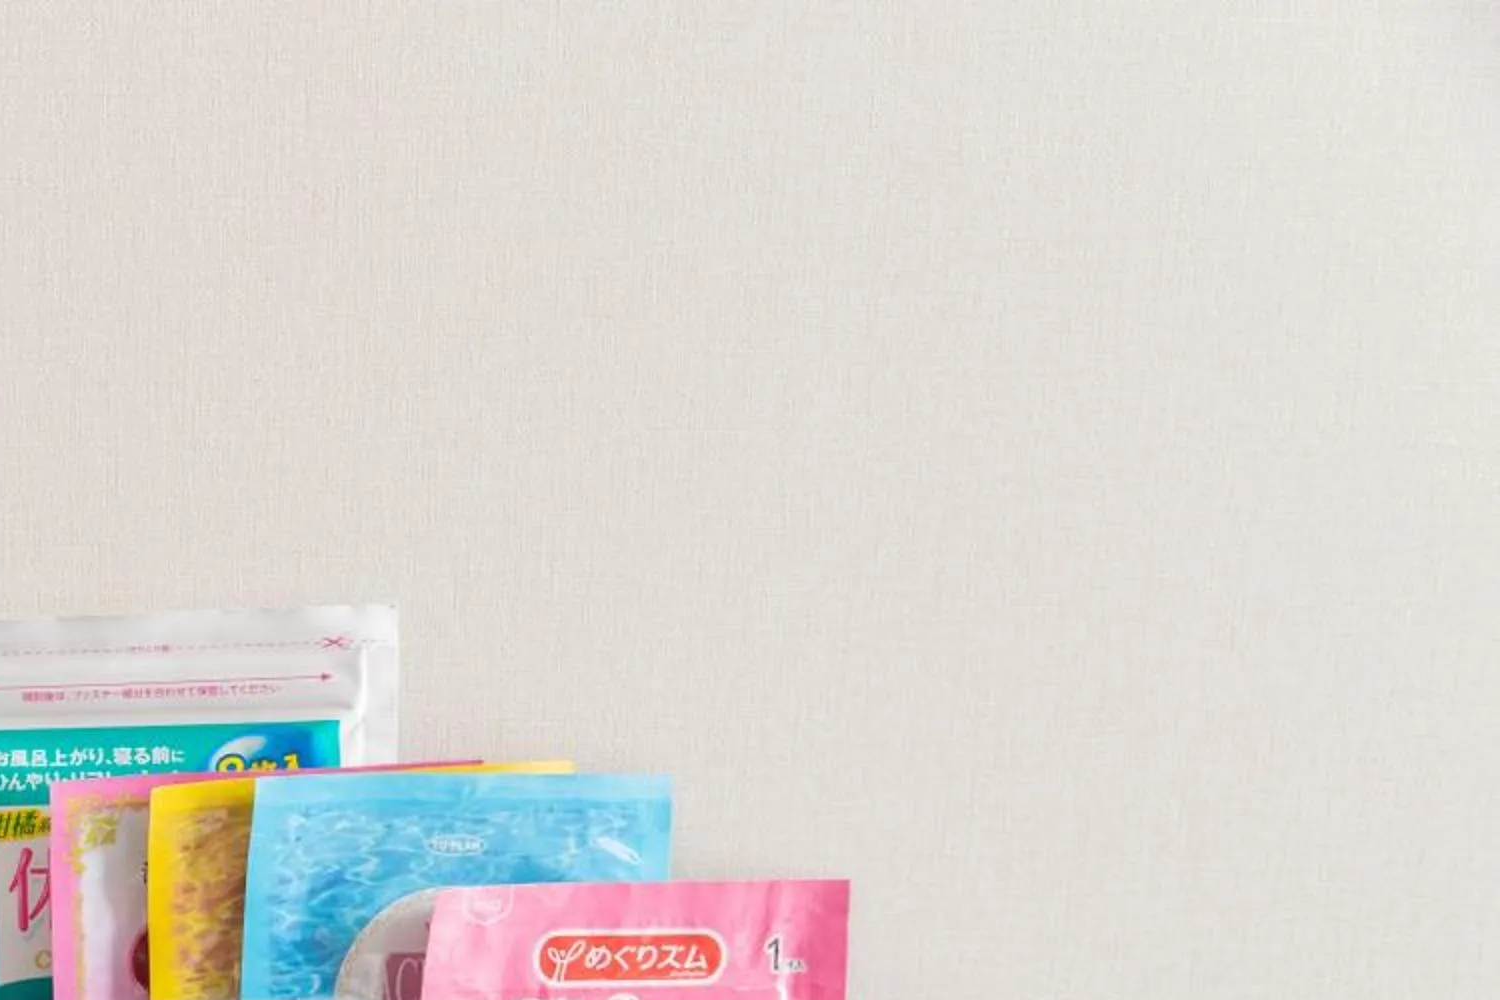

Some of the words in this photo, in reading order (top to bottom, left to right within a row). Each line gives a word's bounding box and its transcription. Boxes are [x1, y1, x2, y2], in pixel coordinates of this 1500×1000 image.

[585, 944, 708, 971] めぐりズム
